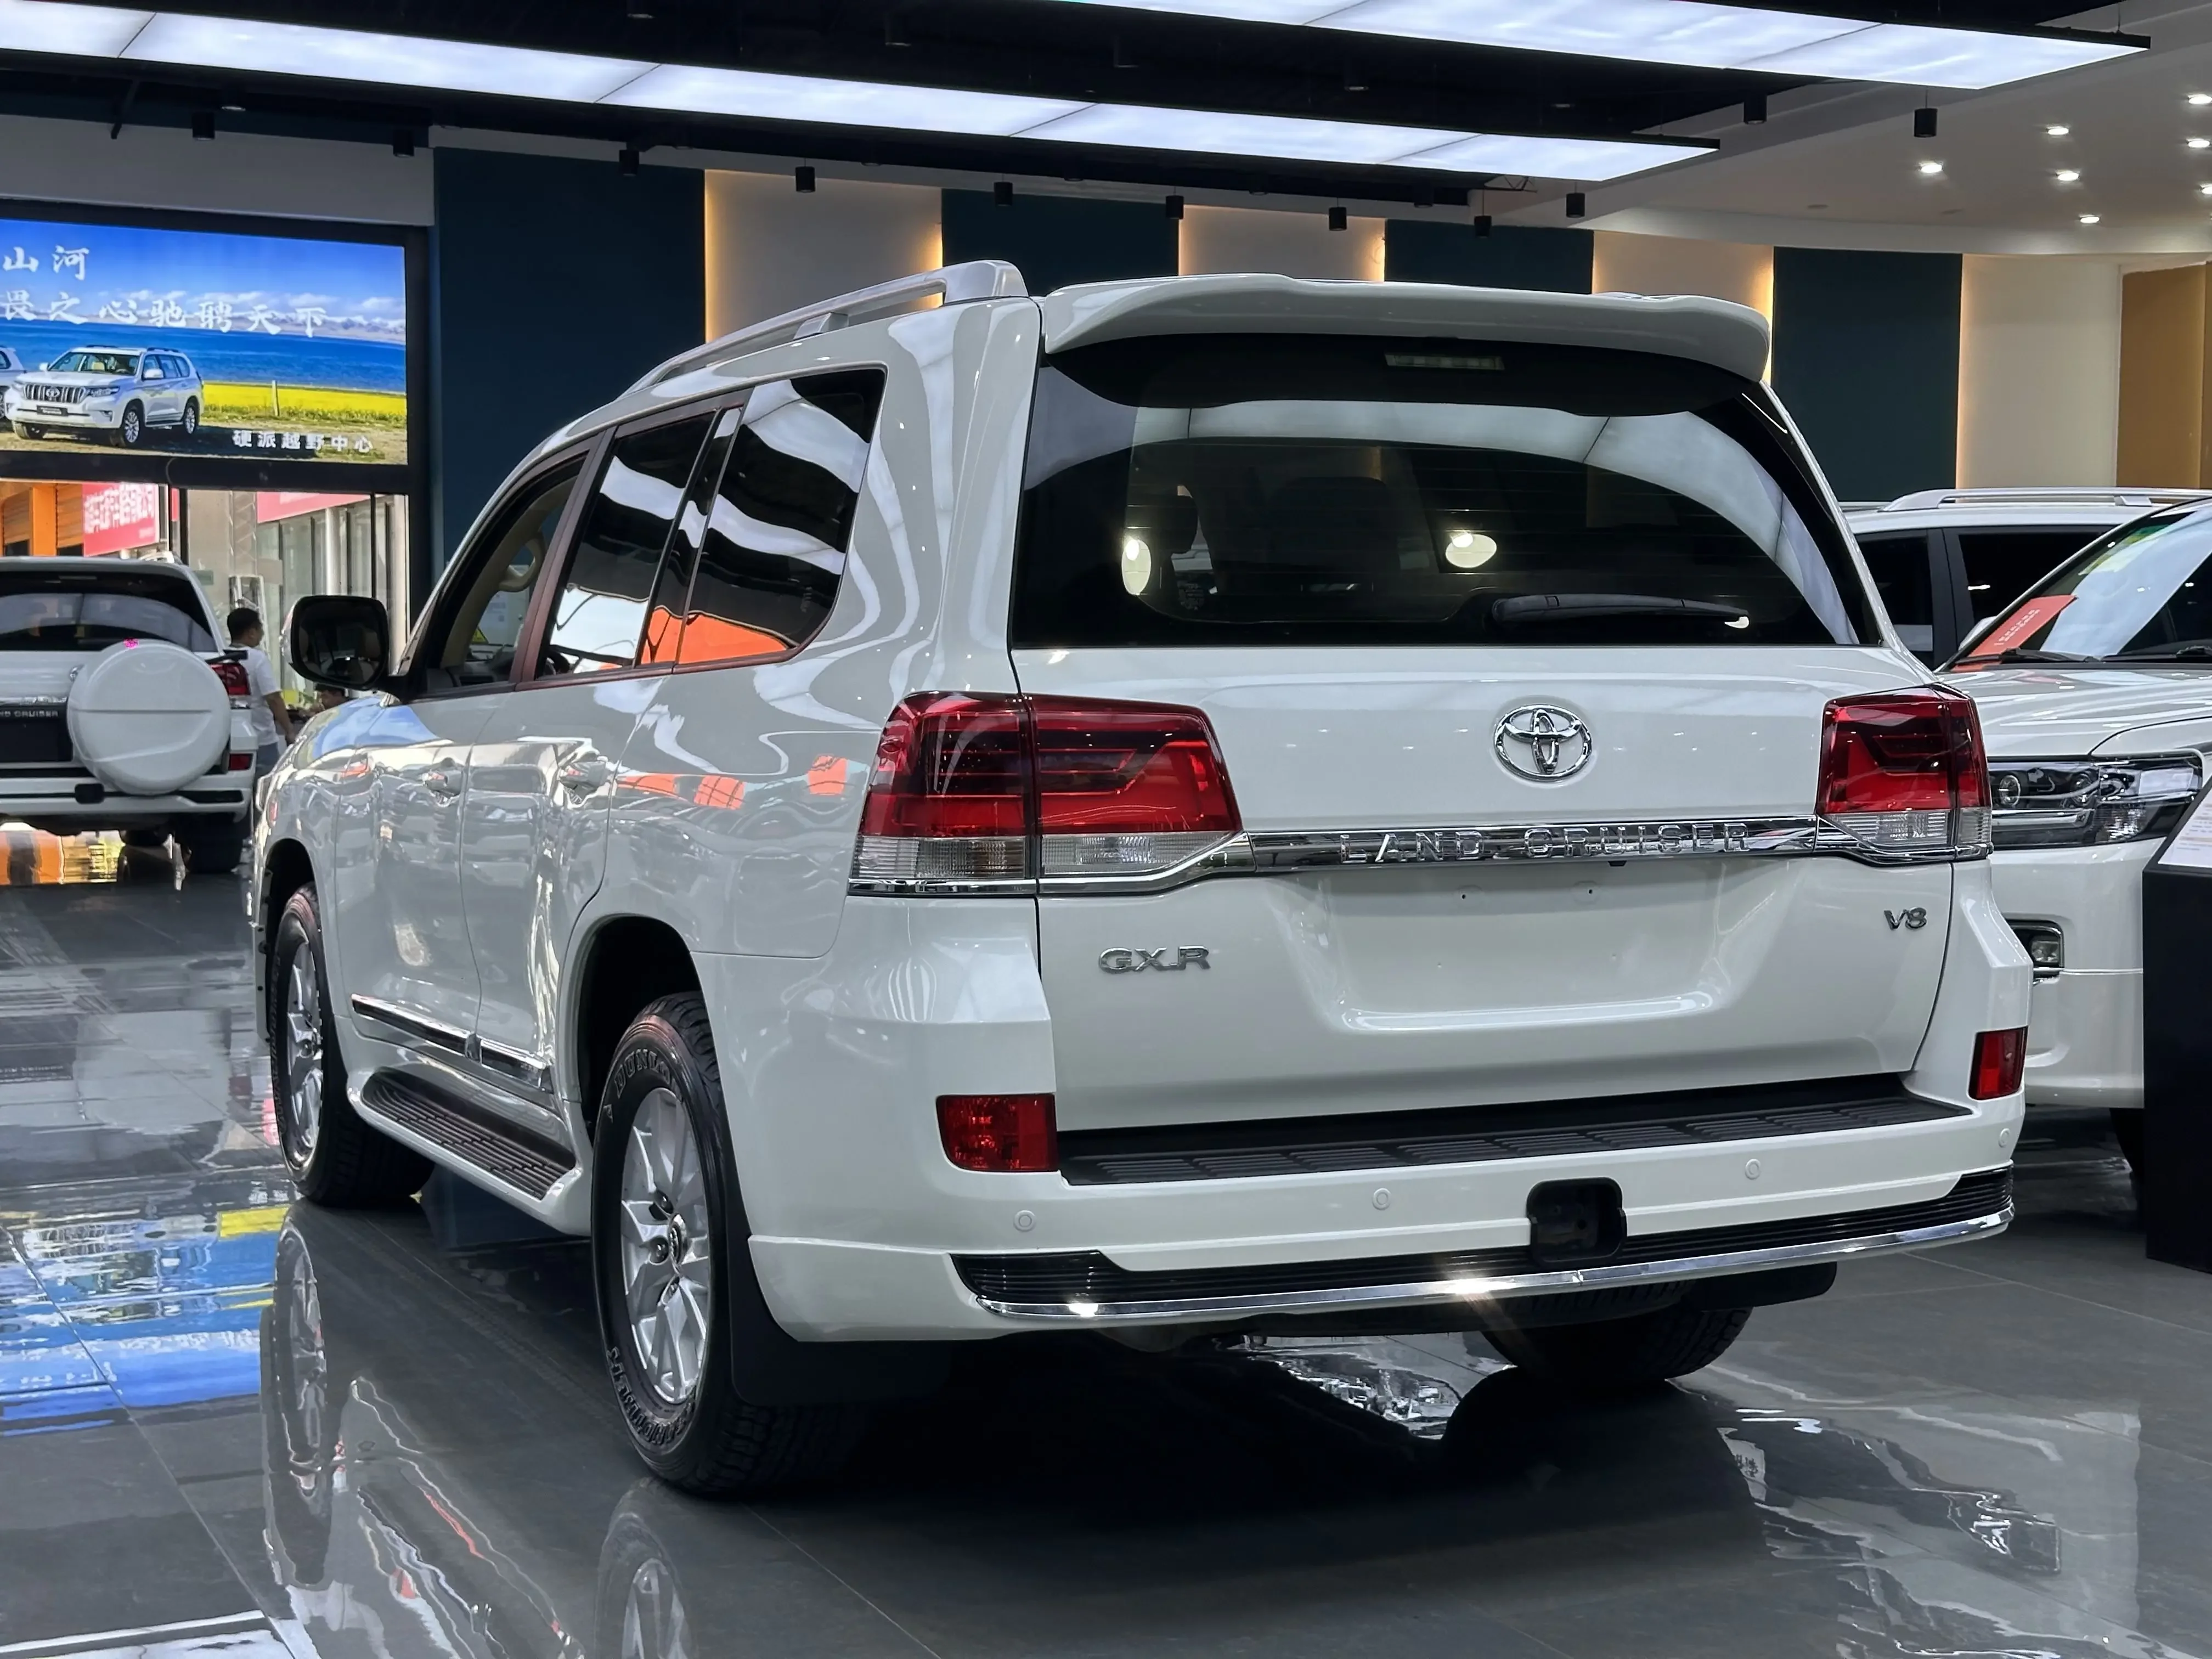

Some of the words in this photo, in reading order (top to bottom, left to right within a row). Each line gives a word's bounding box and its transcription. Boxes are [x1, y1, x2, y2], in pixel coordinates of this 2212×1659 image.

[3, 245, 89, 281] 山河
[232, 430, 373, 453] 硬派越野中心
[1340, 830, 1484, 864] LAND
[1524, 822, 1749, 859] CRUISER
[1883, 907, 1927, 930] V8
[1098, 945, 1211, 974] GXR
